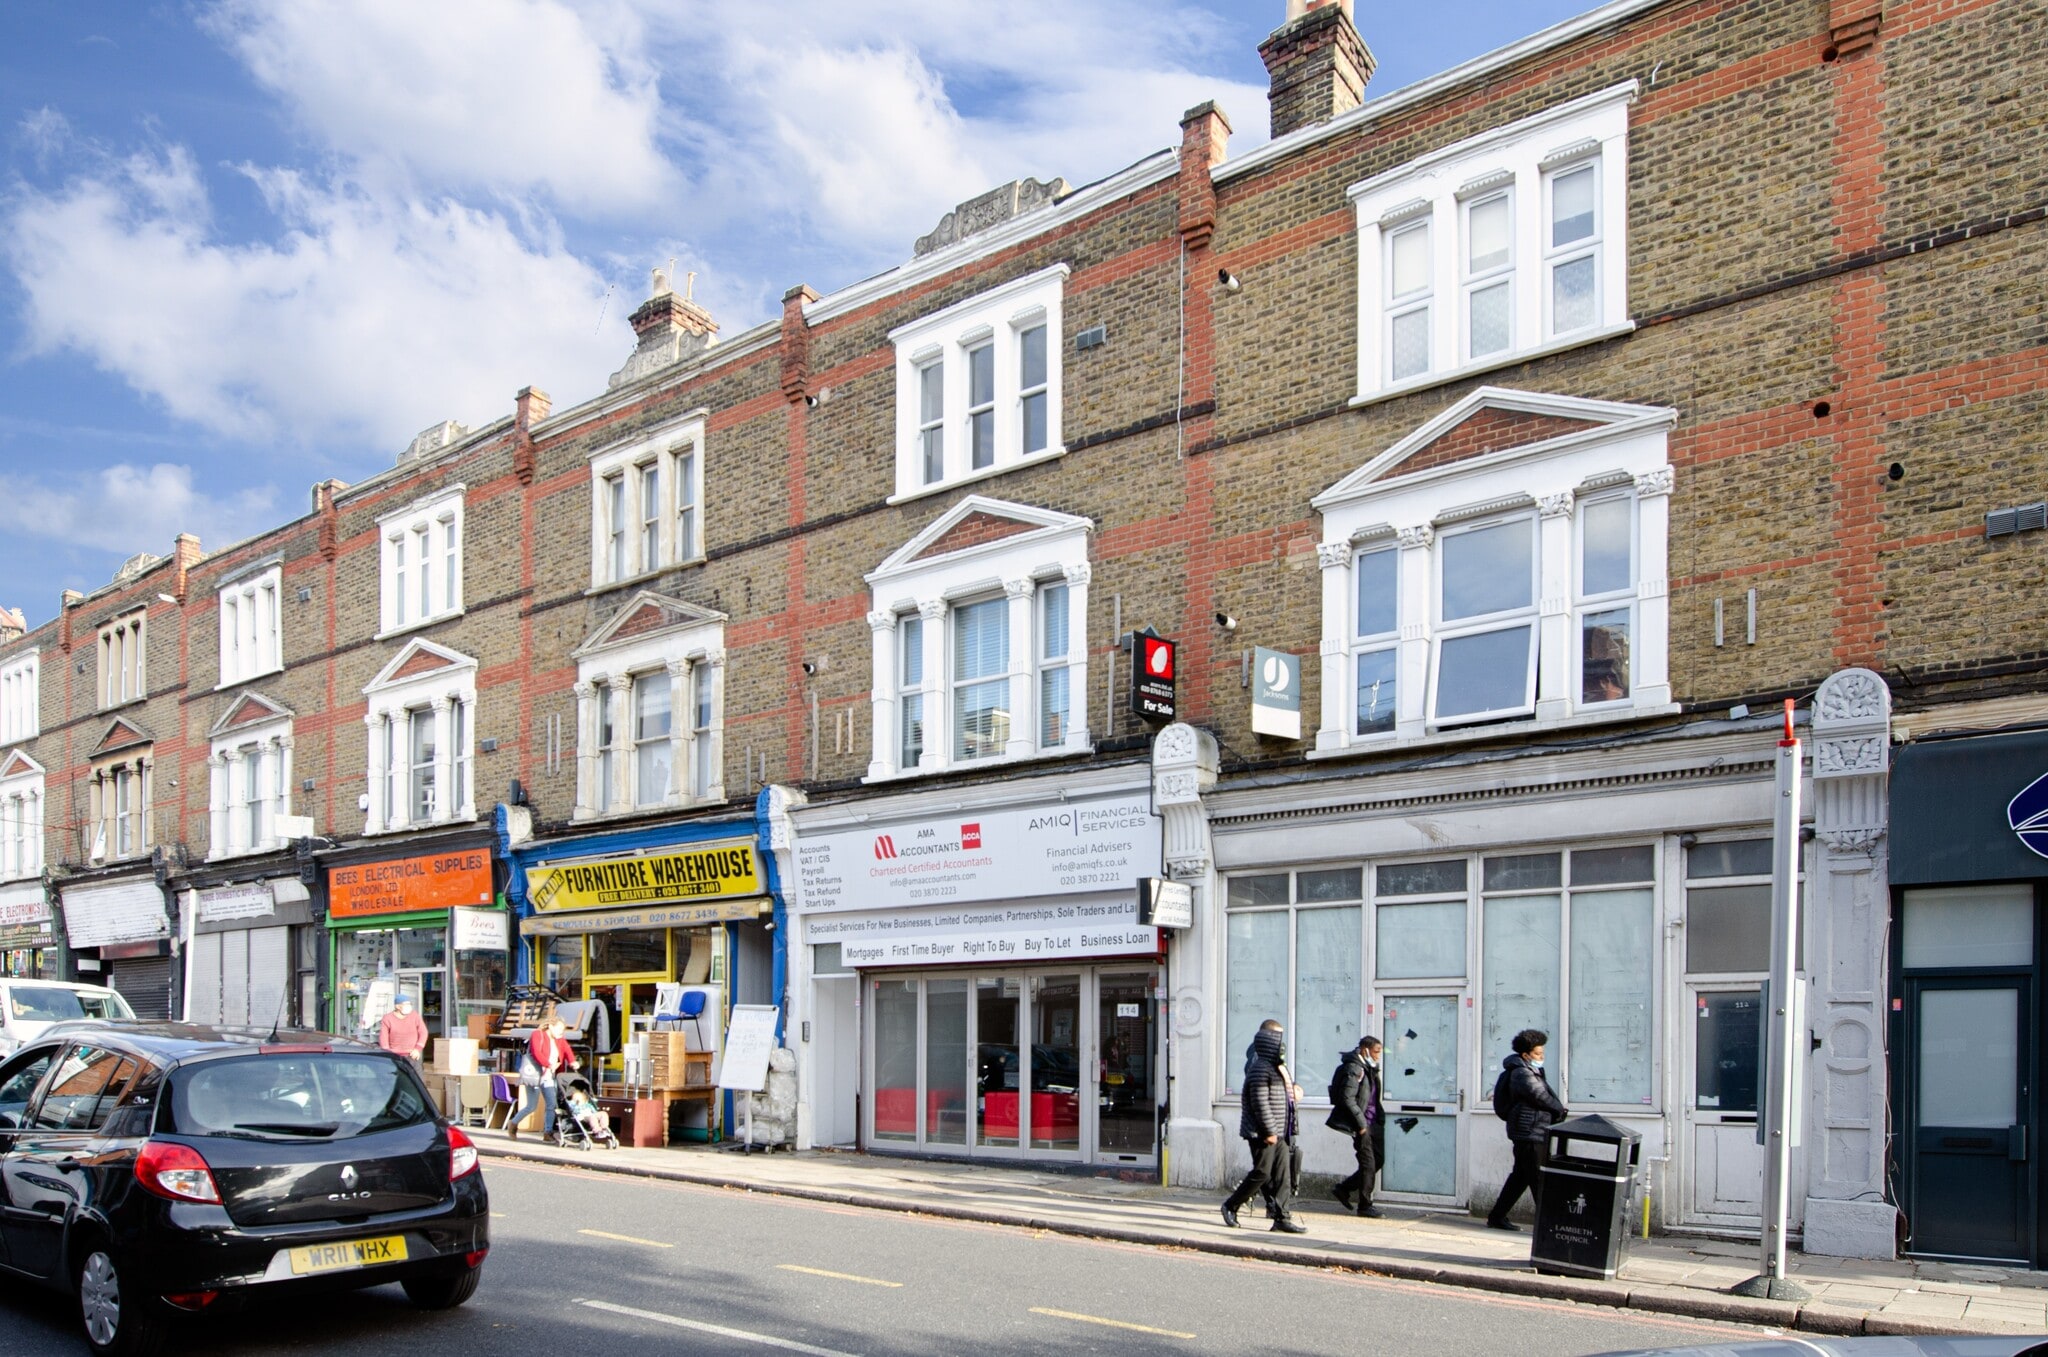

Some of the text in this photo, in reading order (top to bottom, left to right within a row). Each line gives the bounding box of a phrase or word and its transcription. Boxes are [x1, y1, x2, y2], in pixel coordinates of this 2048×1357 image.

[1263, 688, 1289, 700] Jacksons
[1144, 700, 1174, 715] For Sale
[1029, 806, 1147, 830] AMIQ FINANCIAL
[1082, 818, 1146, 832] SERVICES
[917, 828, 936, 840] AMA
[962, 832, 980, 840] ACCA
[800, 845, 830, 854] Accounts
[900, 842, 960, 858] ACCOUNTANTS
[1046, 842, 1132, 858] Financial Advisers
[800, 856, 812, 864] VAT
[818, 854, 830, 864] CIS
[1052, 857, 1128, 872] info@amiqfs.co.uk
[336, 855, 482, 885] BEES ELECTRICAL SUPPLIES
[564, 849, 752, 894] FURNITURE WAREHOUSE
[801, 866, 824, 877] Payroll
[870, 856, 992, 878] Chartered Certified Accountants
[816, 877, 842, 885] Returns
[890, 872, 976, 888] info@amaaccountants.com
[1060, 872, 1120, 886] 020 3870 2221
[350, 882, 398, 897] (LONDON) LTD
[537, 870, 564, 908] TRADE
[600, 892, 619, 902] FREE
[620, 888, 656, 901] DELIVERY
[662, 886, 677, 897] 020
[678, 884, 698, 896] 8677
[700, 882, 719, 894] 3401
[817, 887, 841, 896] Refund
[910, 886, 957, 898] 020 3870 2223
[6, 902, 40, 918] ELECTRONICS
[352, 896, 404, 910] WHOLESALE
[805, 899, 836, 908] Start Ups
[470, 914, 495, 930] Bees
[552, 920, 593, 929] REMOVALS
[604, 915, 641, 925] STORAGE
[650, 914, 666, 922] 020
[669, 911, 691, 920] 8677
[810, 922, 838, 935] Specialist
[839, 920, 866, 932] Services
[866, 920, 878, 930] For
[878, 920, 892, 929] New
[894, 917, 933, 929] Businesses,
[935, 914, 960, 926] Limited
[963, 912, 1004, 926] Companies,
[1006, 908, 1056, 921] Partnerships,
[1057, 906, 1074, 918] Sole
[1076, 904, 1105, 916] Traders
[1107, 903, 1123, 914] and
[846, 932, 1150, 960] Mortgages First Time Buyer Right To Buy Buy To Let Business Loan
[1119, 1006, 1136, 1014] 114
[328, 1191, 371, 1201] CLIO
[1555, 1224, 1593, 1236] LAMBETH
[1555, 1233, 1588, 1244] COUNCIL
[308, 1240, 391, 1267] WR11 WHX
